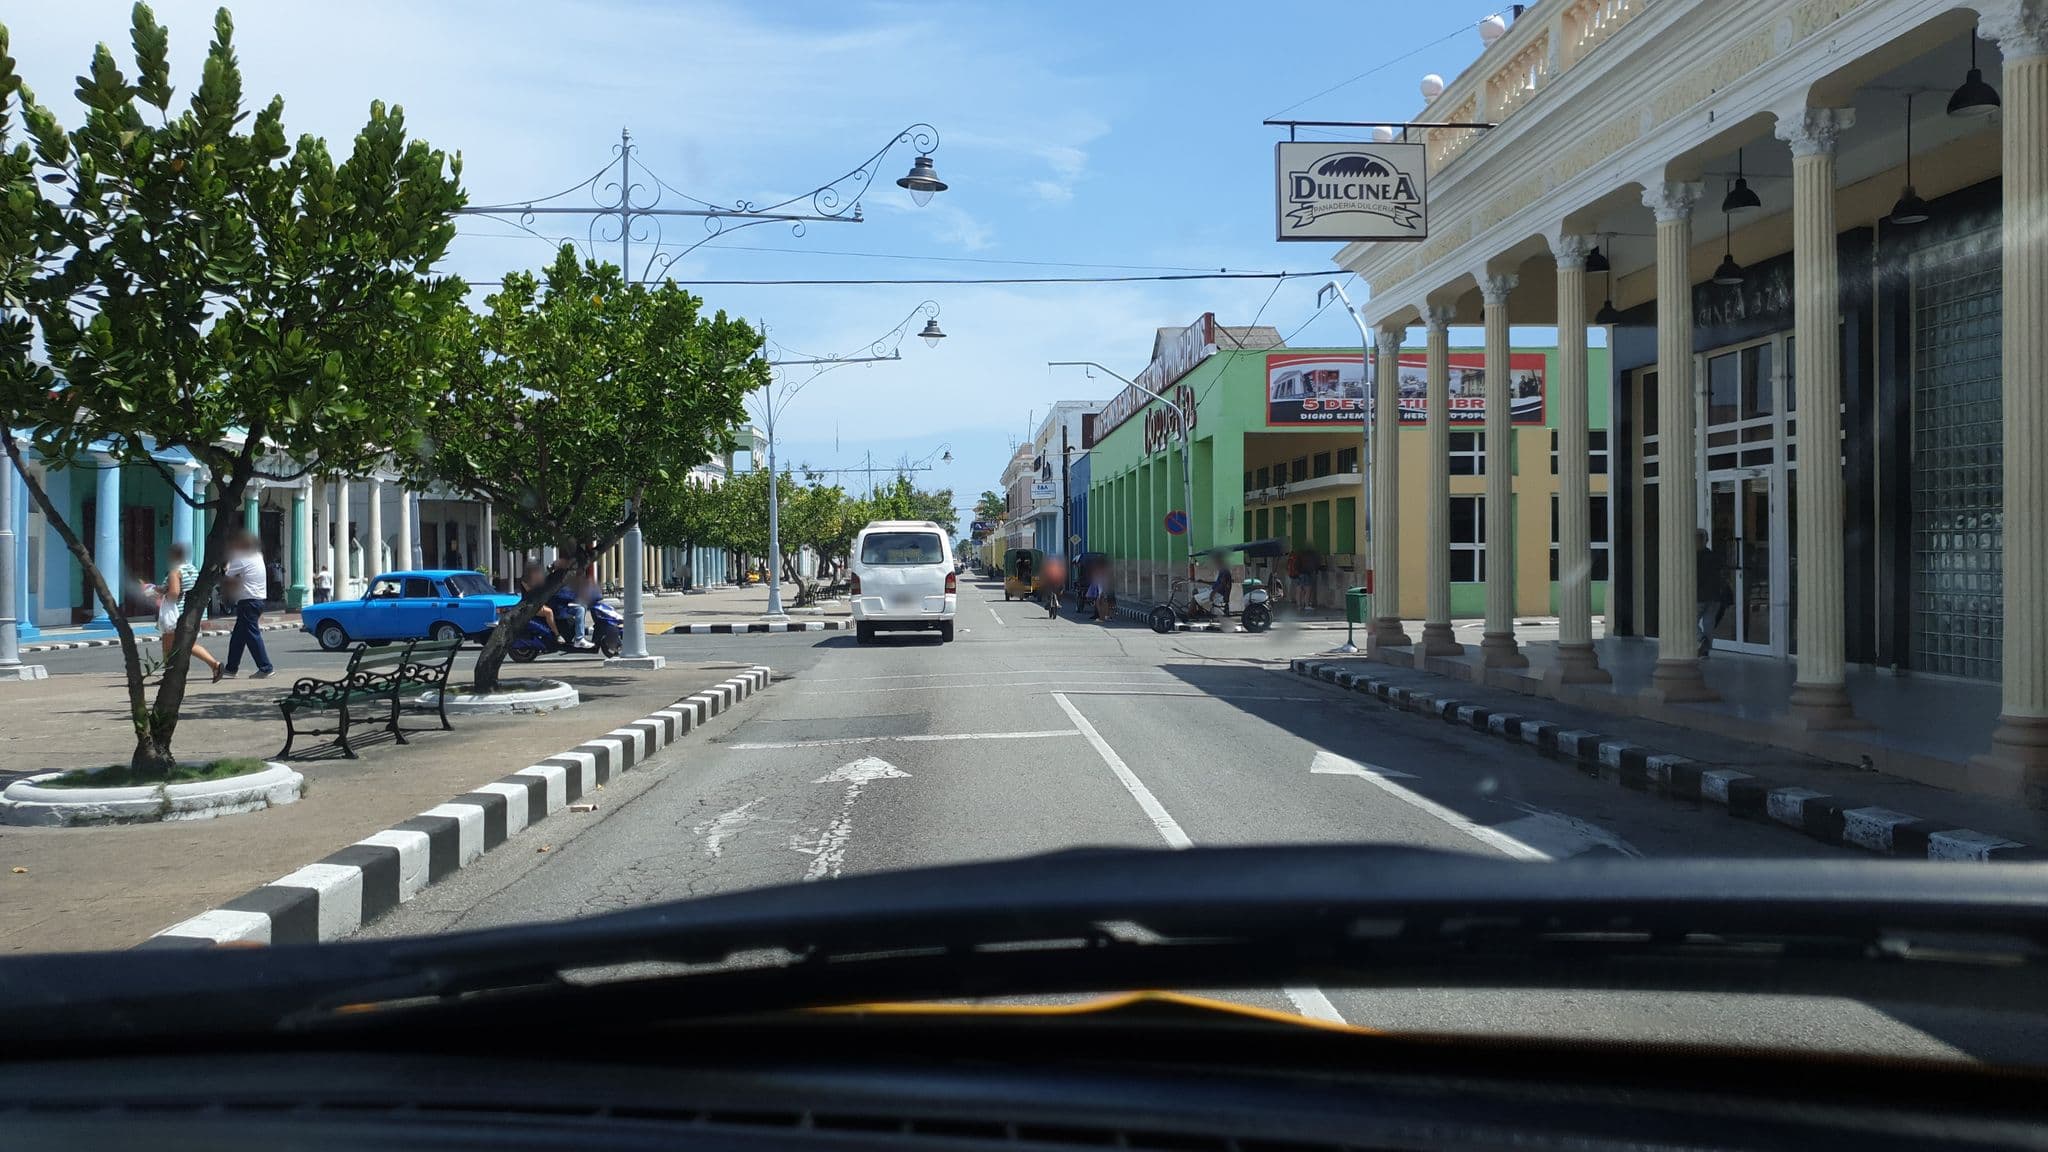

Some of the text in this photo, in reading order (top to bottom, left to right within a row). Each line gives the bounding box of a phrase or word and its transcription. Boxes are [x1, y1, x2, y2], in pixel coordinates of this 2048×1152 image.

[1303, 397, 1320, 411] 5
[1324, 397, 1355, 410] DE
[1300, 412, 1333, 420] DIGNO
